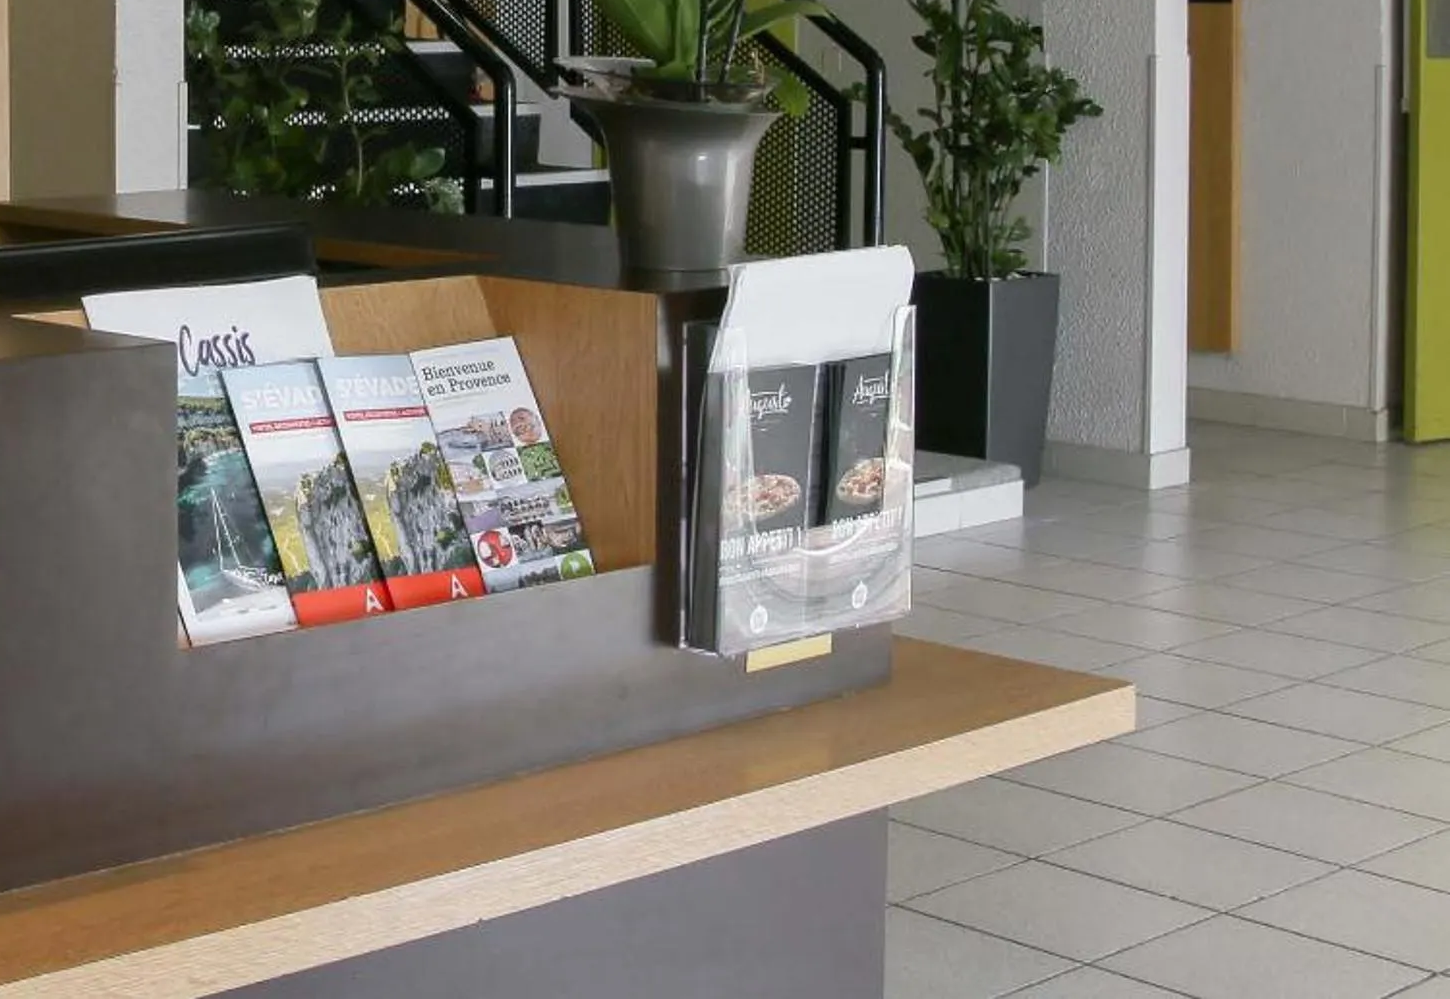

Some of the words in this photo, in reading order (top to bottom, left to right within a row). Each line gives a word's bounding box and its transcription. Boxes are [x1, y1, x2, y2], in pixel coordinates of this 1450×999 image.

[179, 324, 256, 377] Cassis
[422, 360, 495, 381] Bienvenue
[427, 383, 446, 397] en
[448, 373, 511, 393] Provence
[451, 573, 468, 599] A
[366, 586, 384, 613] A
